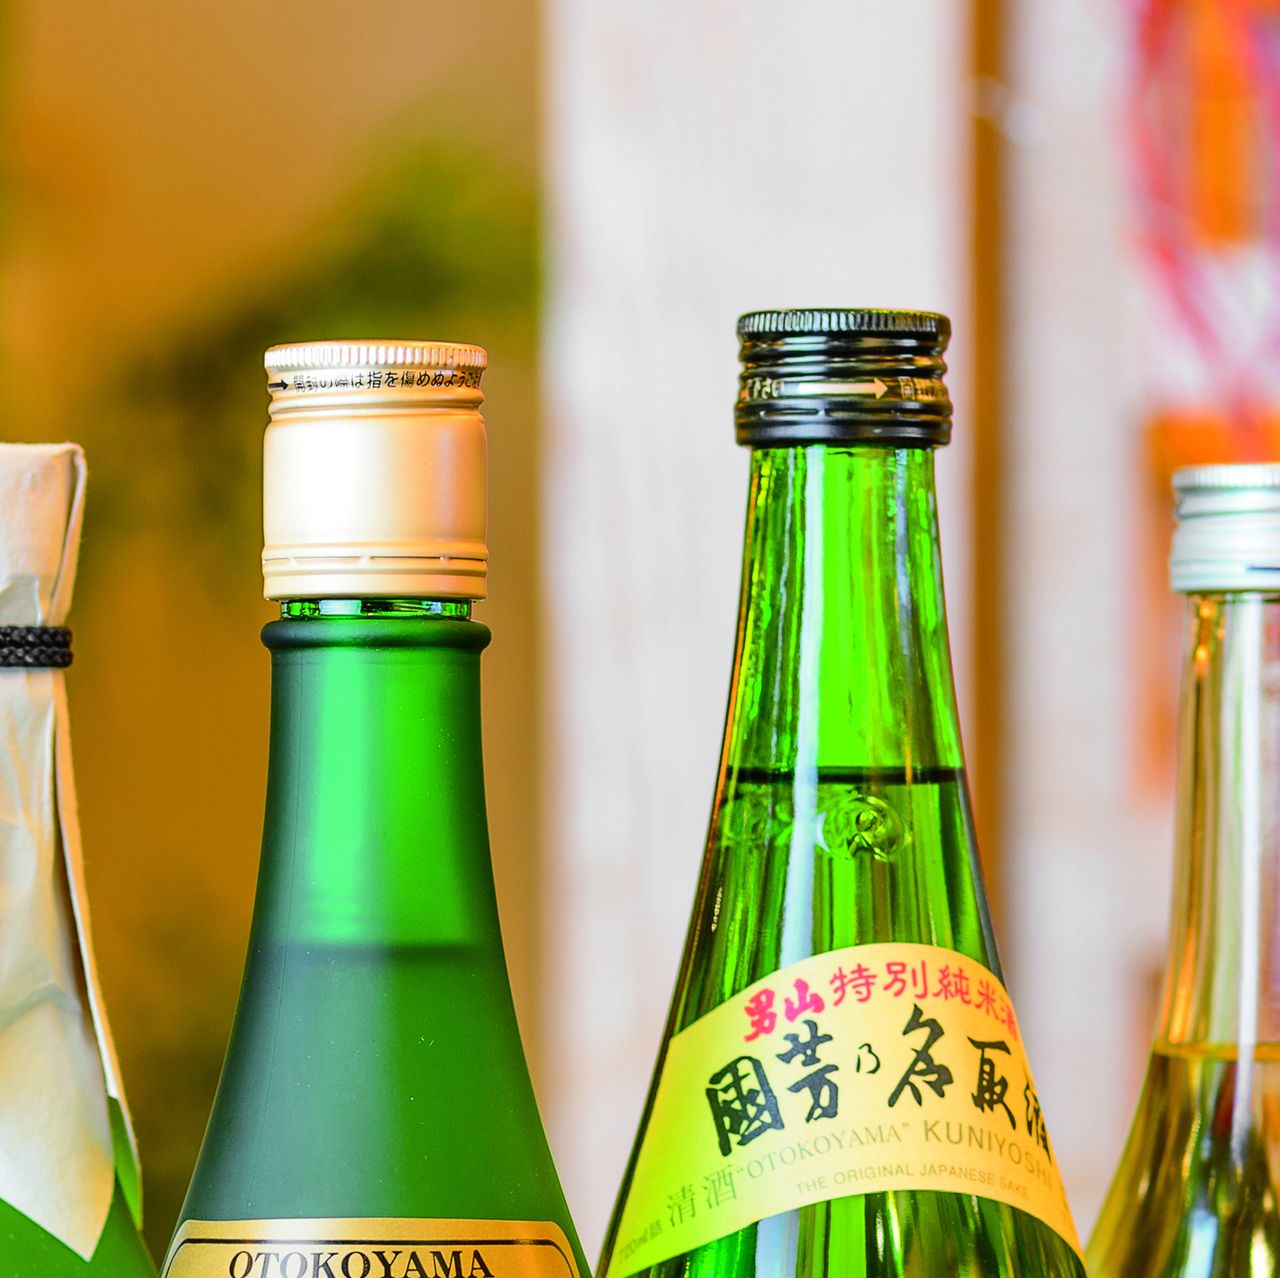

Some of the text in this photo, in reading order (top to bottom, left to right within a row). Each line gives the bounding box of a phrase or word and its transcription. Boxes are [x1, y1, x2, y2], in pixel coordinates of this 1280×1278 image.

[664, 1162, 738, 1230] 清酒
[924, 1120, 1053, 1192] KUNIYOSHI
[795, 1164, 1029, 1199] THE ORIGINAL JAPANESE SAKE
